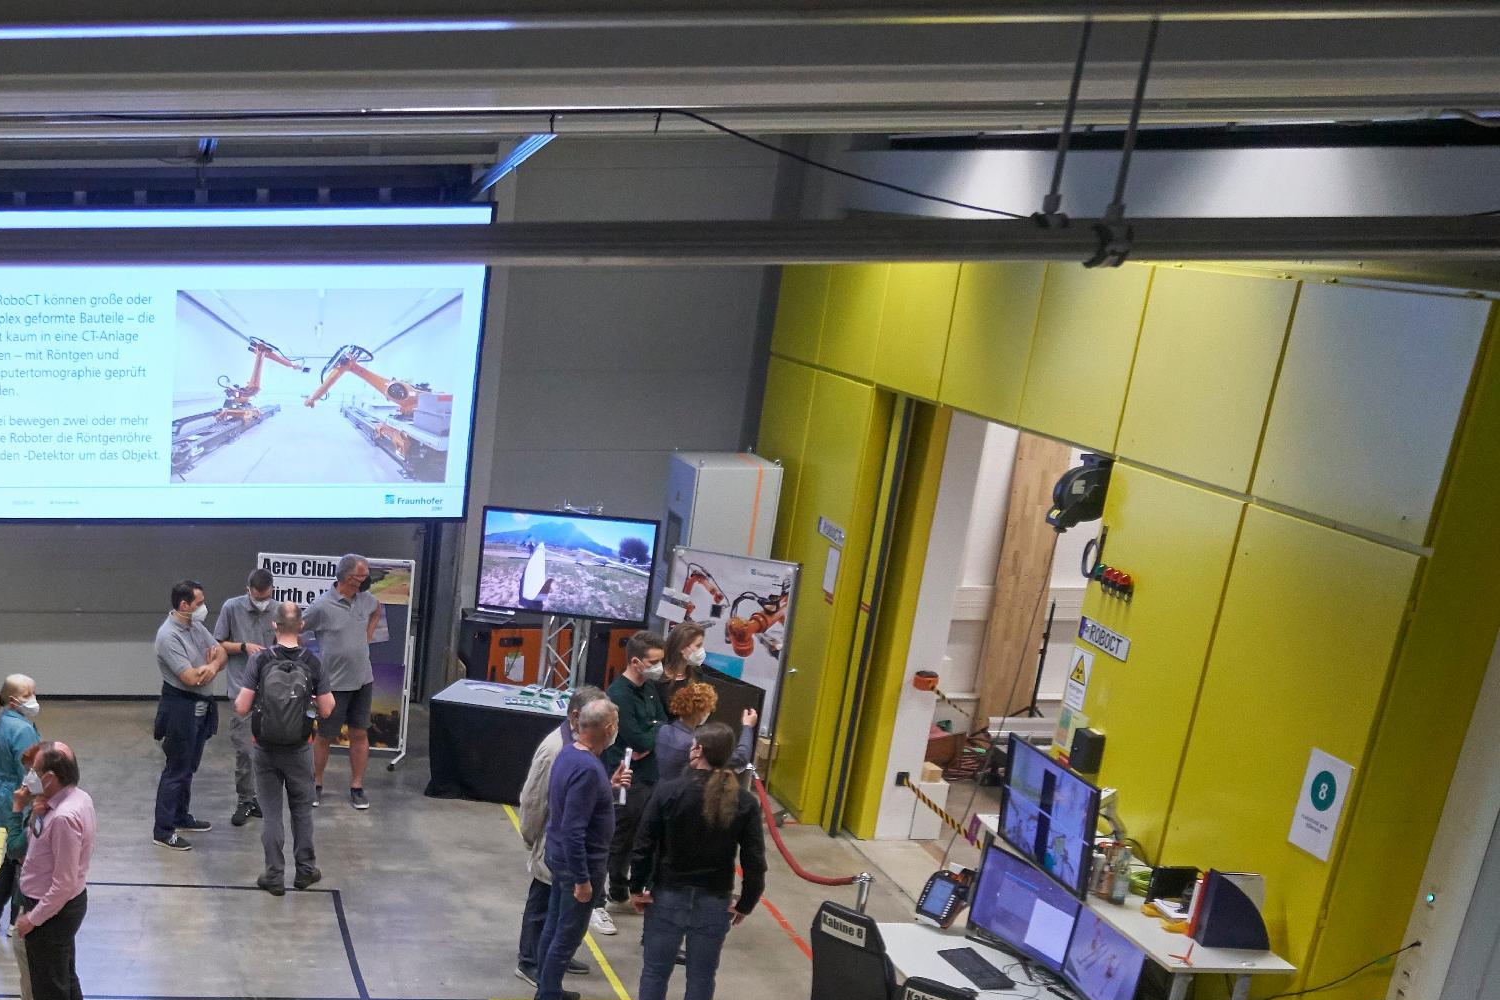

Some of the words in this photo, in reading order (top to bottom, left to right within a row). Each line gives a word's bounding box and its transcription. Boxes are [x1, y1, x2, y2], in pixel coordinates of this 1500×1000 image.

[44, 294, 87, 305] können
[90, 294, 123, 307] große
[126, 294, 153, 305] oder
[24, 312, 76, 326] geformte
[80, 312, 124, 324] Bauteile
[137, 312, 155, 323] die
[6, 331, 37, 342] kaum
[41, 331, 51, 341] in
[55, 331, 78, 341] eine
[81, 330, 139, 344] CT-Anlage
[25, 350, 43, 360] mit
[47, 349, 94, 362] Röntgen
[97, 349, 120, 360] und
[104, 366, 147, 380] geprüft
[9, 415, 60, 428] bewegen
[63, 416, 88, 426] zwei
[91, 415, 117, 426] oder
[120, 415, 148, 426] mehr
[10, 432, 53, 443] Roboter
[56, 432, 73, 443] die
[76, 432, 152, 445] Röntgenröhre
[0, 450, 20, 460] den
[23, 450, 74, 461] -Detektor
[78, 452, 96, 461] um
[100, 450, 118, 460] das
[122, 450, 160, 462] Objekt.
[397, 497, 443, 505] Fraunhofer
[263, 558, 297, 575] Aero
[302, 560, 337, 578] Club
[272, 587, 302, 604] ürth
[1089, 623, 1123, 655] ROBOCT
[1318, 782, 1328, 800] 8
[822, 913, 854, 936] Kabine
[856, 928, 864, 940] 8
